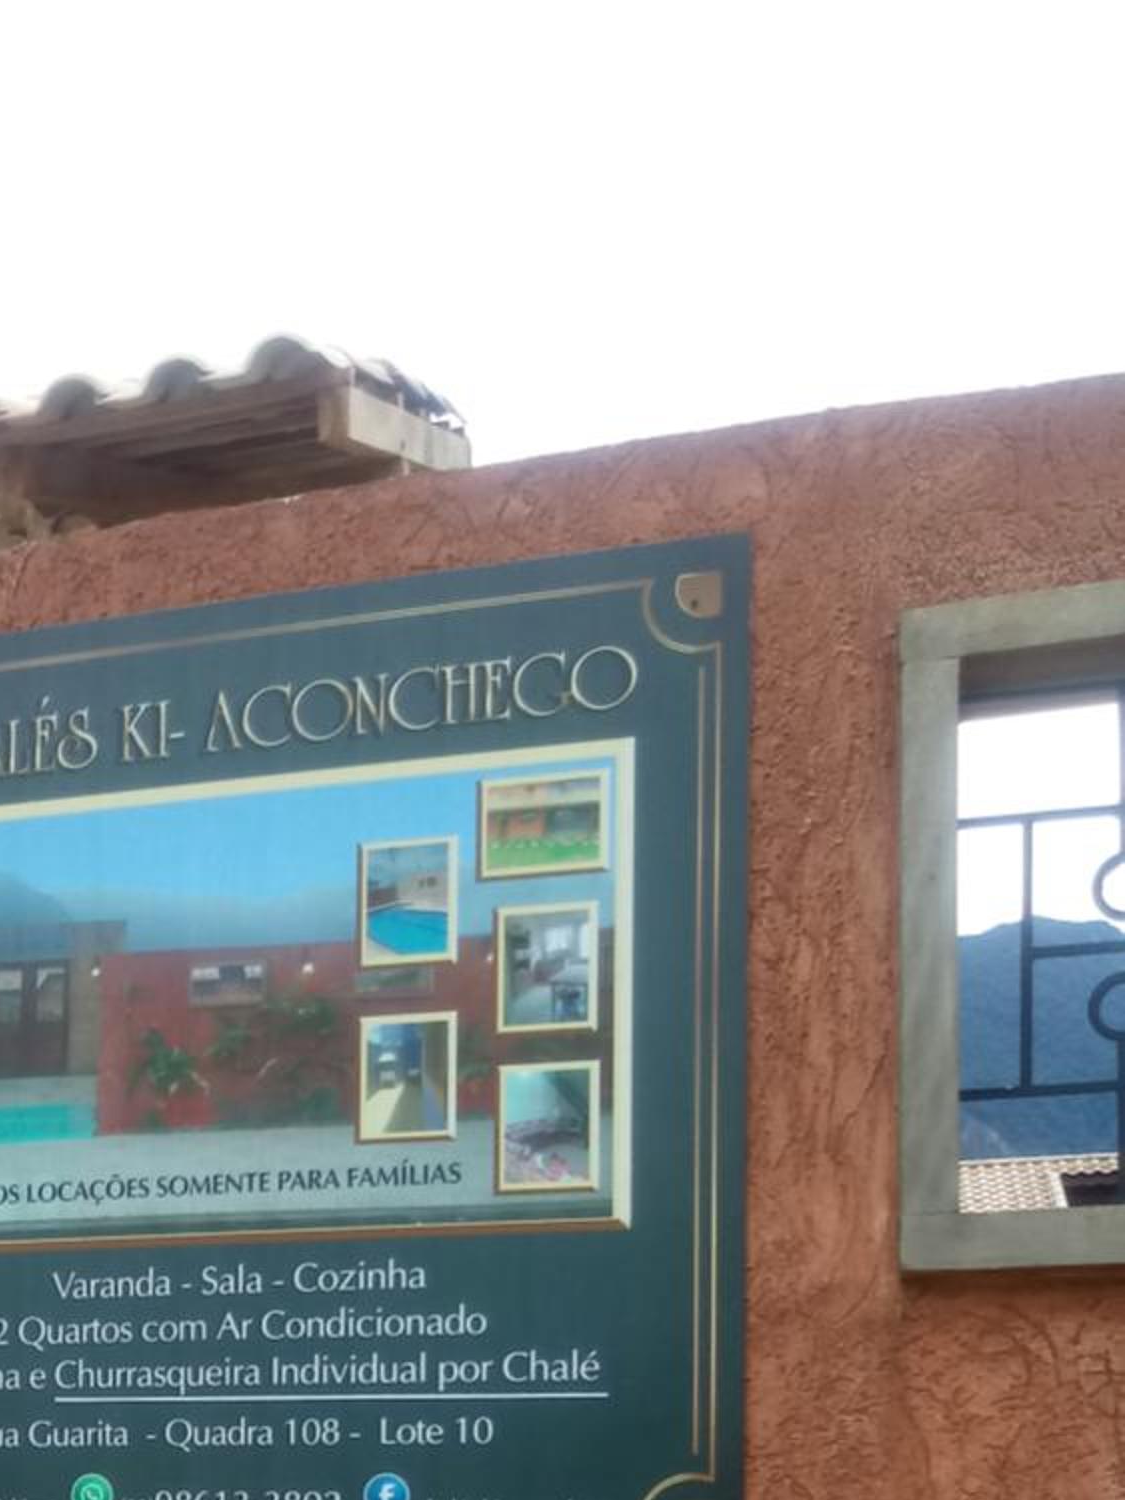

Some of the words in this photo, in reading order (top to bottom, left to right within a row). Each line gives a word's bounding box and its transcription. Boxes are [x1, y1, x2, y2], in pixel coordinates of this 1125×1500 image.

[26, 1174, 150, 1206] LOCAÇÕES
[155, 1171, 272, 1199] SOMENTE
[277, 1168, 340, 1192] PARA
[346, 1159, 463, 1189] FAMÍLIAS
[51, 1266, 172, 1300] Varanda
[201, 1263, 263, 1296] Sala
[293, 1258, 427, 1293] Cozinha
[17, 1316, 133, 1351] Quartos
[141, 1317, 208, 1343] com
[216, 1312, 253, 1341] Ar
[261, 1302, 488, 1340] Condicionado
[28, 1370, 48, 1390] e
[54, 1357, 262, 1396] Churrasqueira
[272, 1350, 428, 1386] Individual
[437, 1356, 494, 1392] por
[502, 1348, 601, 1384] Chalé
[28, 1418, 129, 1448] Guarita
[164, 1416, 274, 1452] Quadra
[286, 1417, 341, 1446] 108
[379, 1417, 445, 1445] Lote
[456, 1416, 495, 1444] 10
